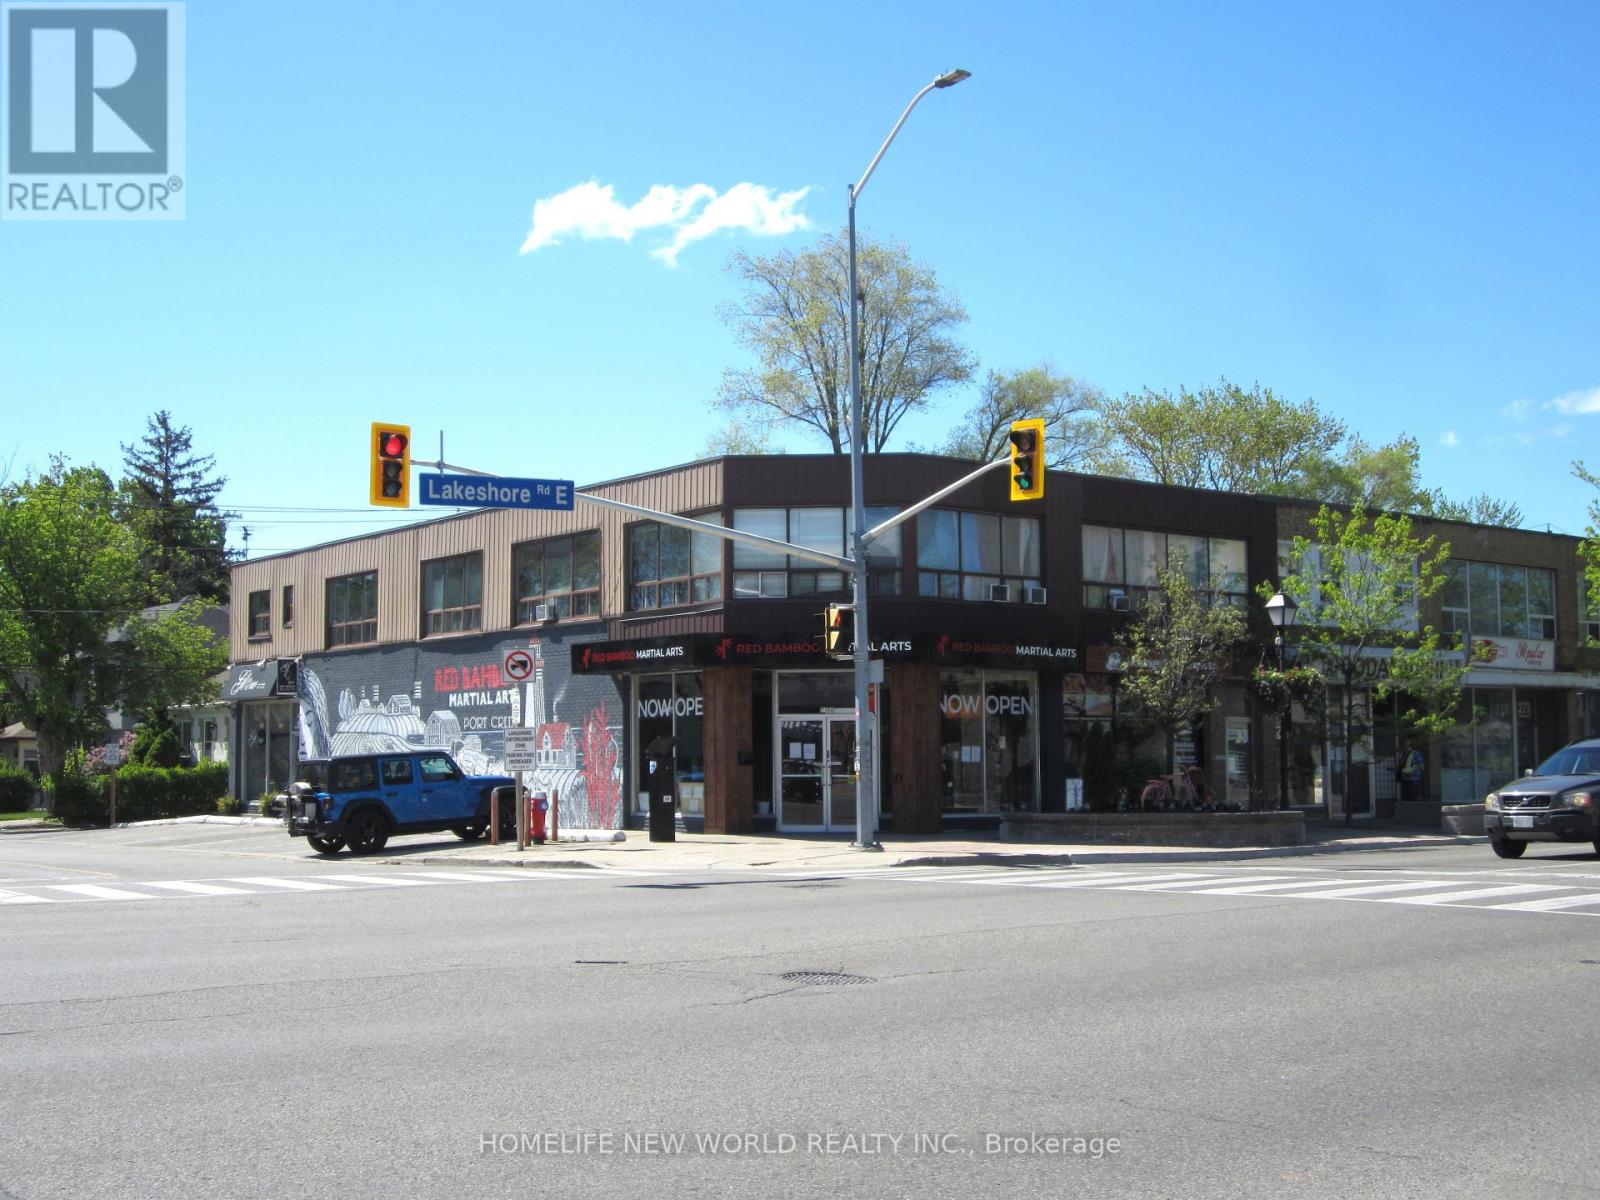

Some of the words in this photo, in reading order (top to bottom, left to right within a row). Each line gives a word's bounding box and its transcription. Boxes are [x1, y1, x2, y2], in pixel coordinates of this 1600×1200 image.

[428, 479, 531, 503] Lakeshore
[537, 484, 550, 495] Rd
[556, 486, 567, 504] E
[636, 647, 664, 659] MARTIAL
[666, 646, 683, 657] ARTS
[736, 643, 762, 654] RED
[765, 642, 820, 654] BAMBOO
[881, 641, 912, 651] ARTS
[952, 642, 971, 653] RED
[1016, 645, 1054, 657] MARTIAL
[1055, 648, 1077, 658] ARTS
[434, 666, 458, 692] RED
[449, 690, 493, 707] MARTIAL
[495, 688, 514, 705] ART
[985, 695, 1034, 715] OPEN
[637, 698, 672, 718] NOW
[675, 696, 704, 717] OPE
[463, 716, 488, 730] PORT
